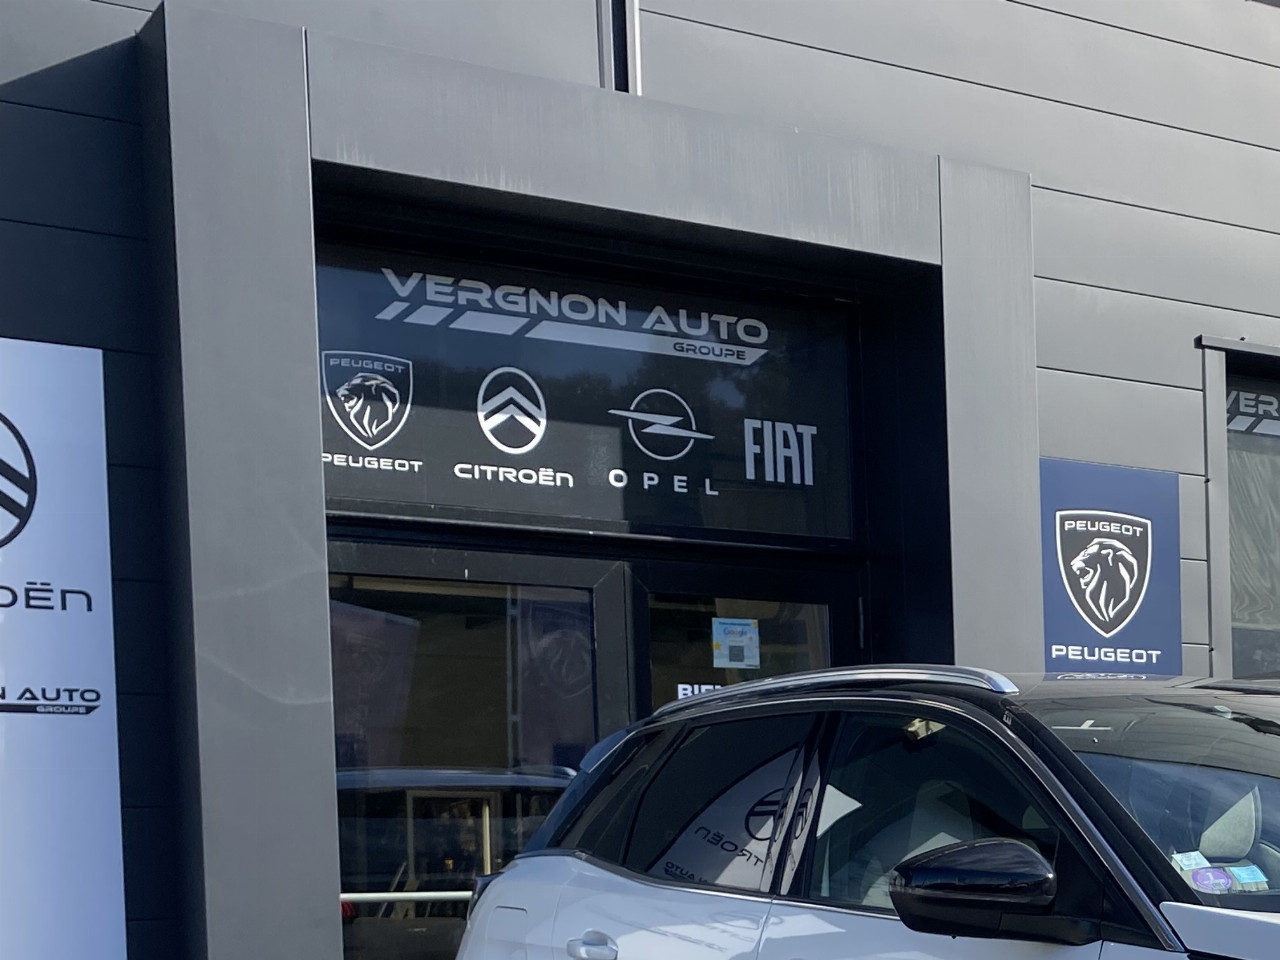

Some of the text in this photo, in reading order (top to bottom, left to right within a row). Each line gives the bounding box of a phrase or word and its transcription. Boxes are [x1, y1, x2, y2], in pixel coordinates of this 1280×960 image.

[381, 267, 769, 344] VERGNON AUTO
[673, 342, 747, 360] GROUPE
[330, 358, 405, 373] PEUGEOT
[744, 418, 817, 486] FIAT
[321, 453, 423, 472] PEUGEOT
[608, 469, 719, 496] OPEL
[1064, 521, 1143, 537] PEUGEOT
[1051, 645, 1161, 664] PEUGEOT
[17, 687, 101, 702] AUTO
[36, 705, 87, 713] GROUPE
